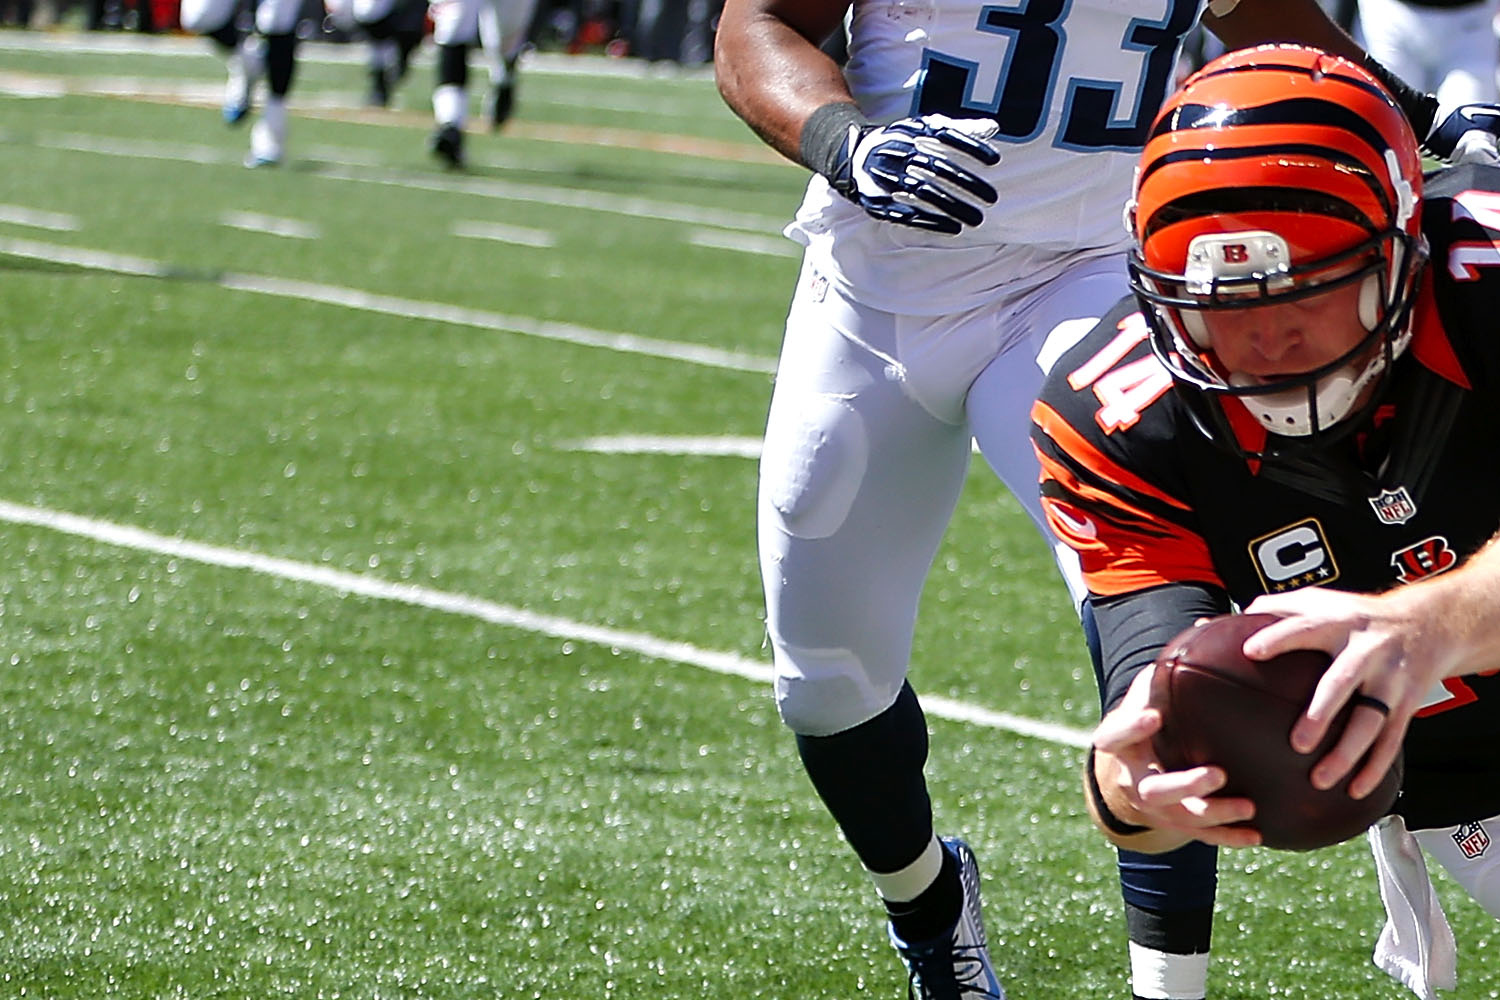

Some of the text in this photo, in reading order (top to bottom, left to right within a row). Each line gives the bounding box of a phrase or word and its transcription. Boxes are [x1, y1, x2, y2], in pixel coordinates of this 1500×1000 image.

[1223, 244, 1249, 264] B
[1066, 311, 1184, 436] 14
[1381, 500, 1411, 520] NFL
[1258, 527, 1325, 581] C
[1460, 832, 1488, 857] NFL
